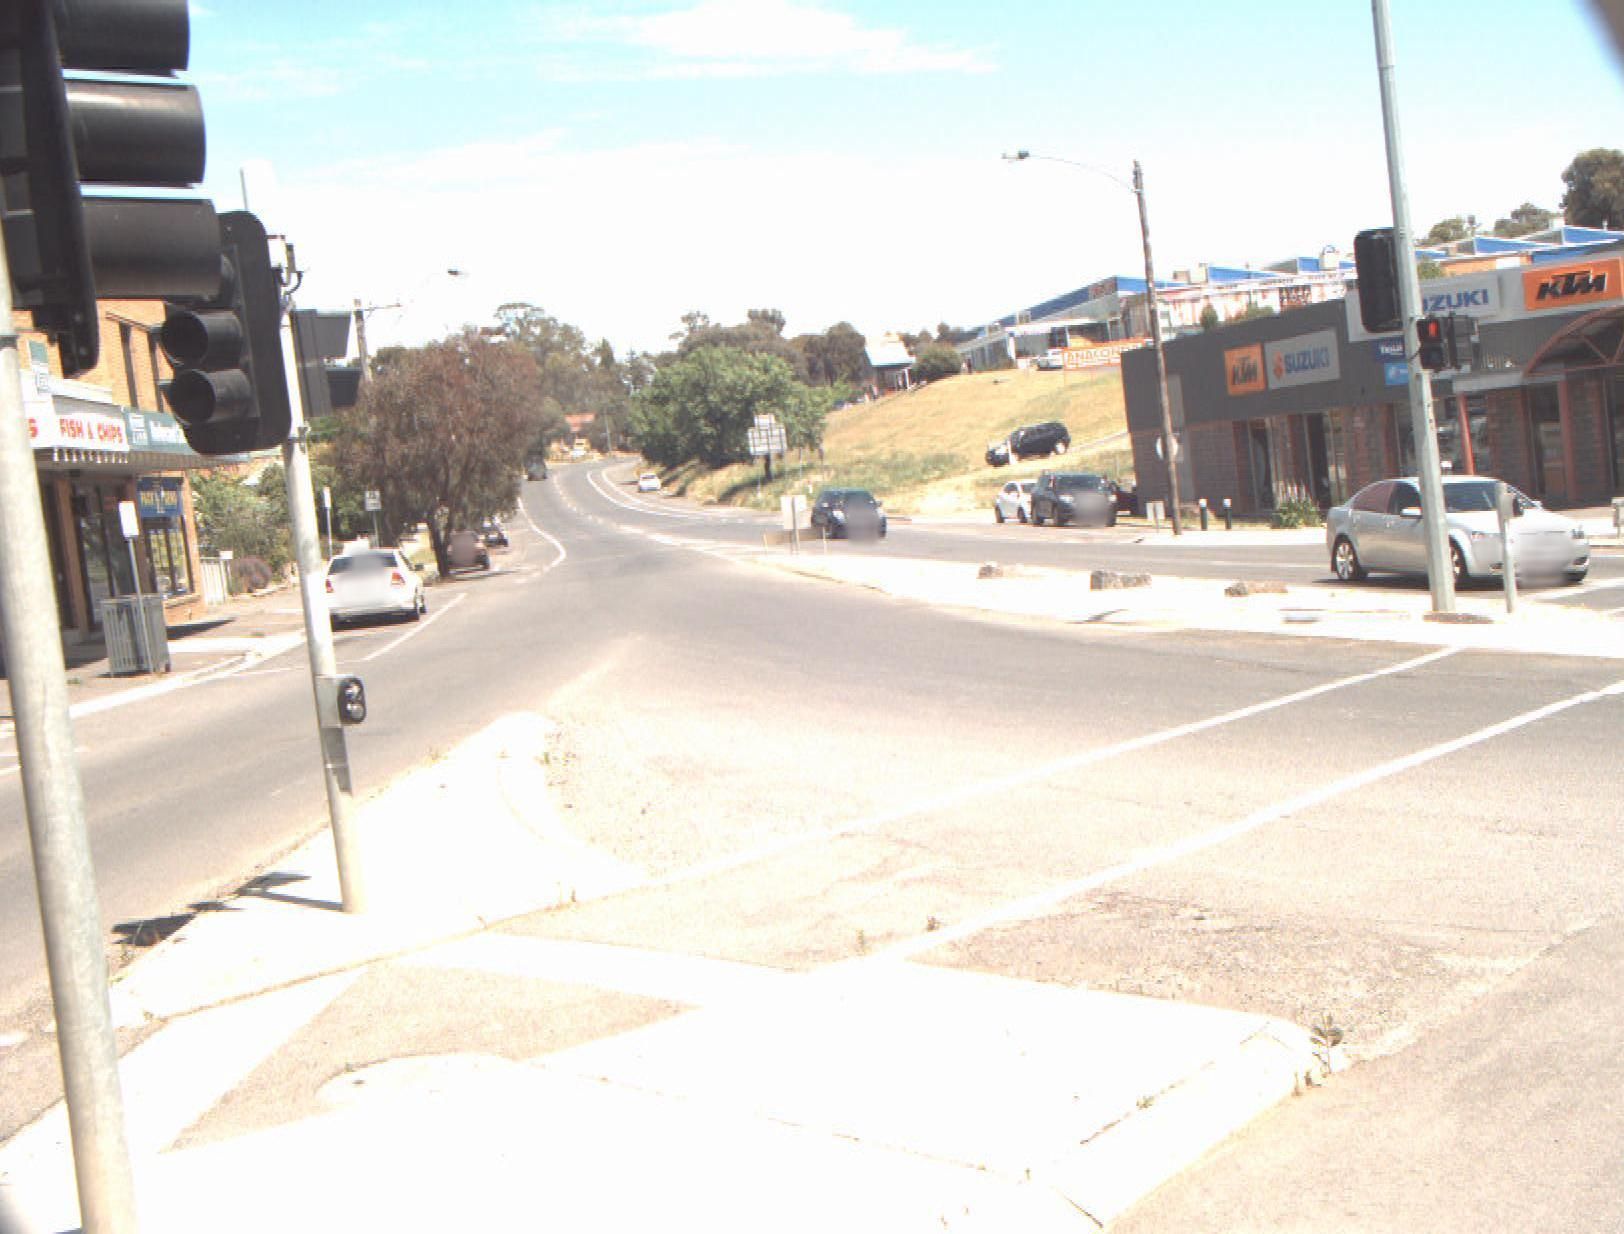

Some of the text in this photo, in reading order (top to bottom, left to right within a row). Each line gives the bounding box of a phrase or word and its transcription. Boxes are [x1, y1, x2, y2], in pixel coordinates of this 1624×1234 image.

[1536, 270, 1606, 300] KTM
[1423, 288, 1488, 312] ZUKI
[1231, 346, 1330, 385] KTM SUZUKI
[59, 417, 84, 439] FISH
[97, 421, 124, 443] CHIPS
